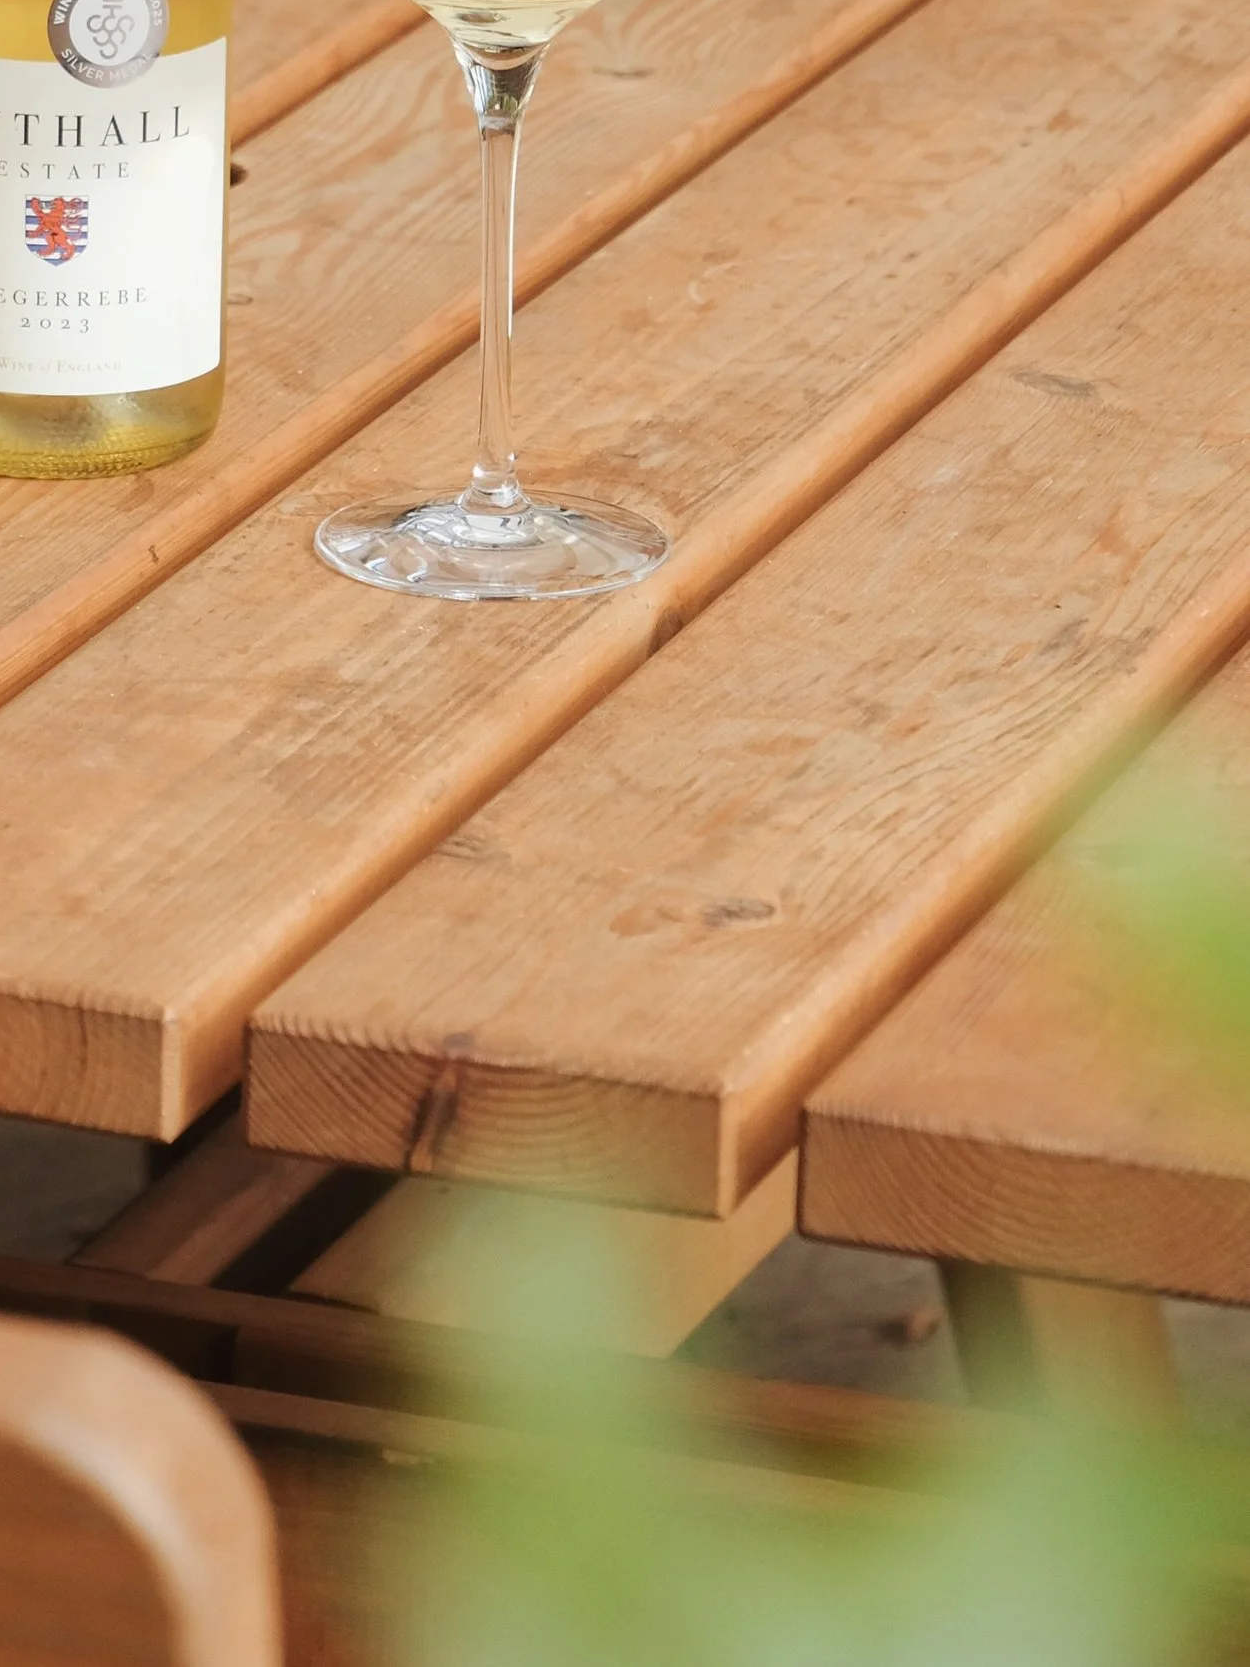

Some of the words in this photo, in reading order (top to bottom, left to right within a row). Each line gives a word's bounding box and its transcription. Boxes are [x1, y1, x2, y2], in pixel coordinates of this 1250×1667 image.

[61, 48, 105, 81] SILVER
[109, 53, 154, 80] MEDAL
[21, 317, 90, 334] 2023
